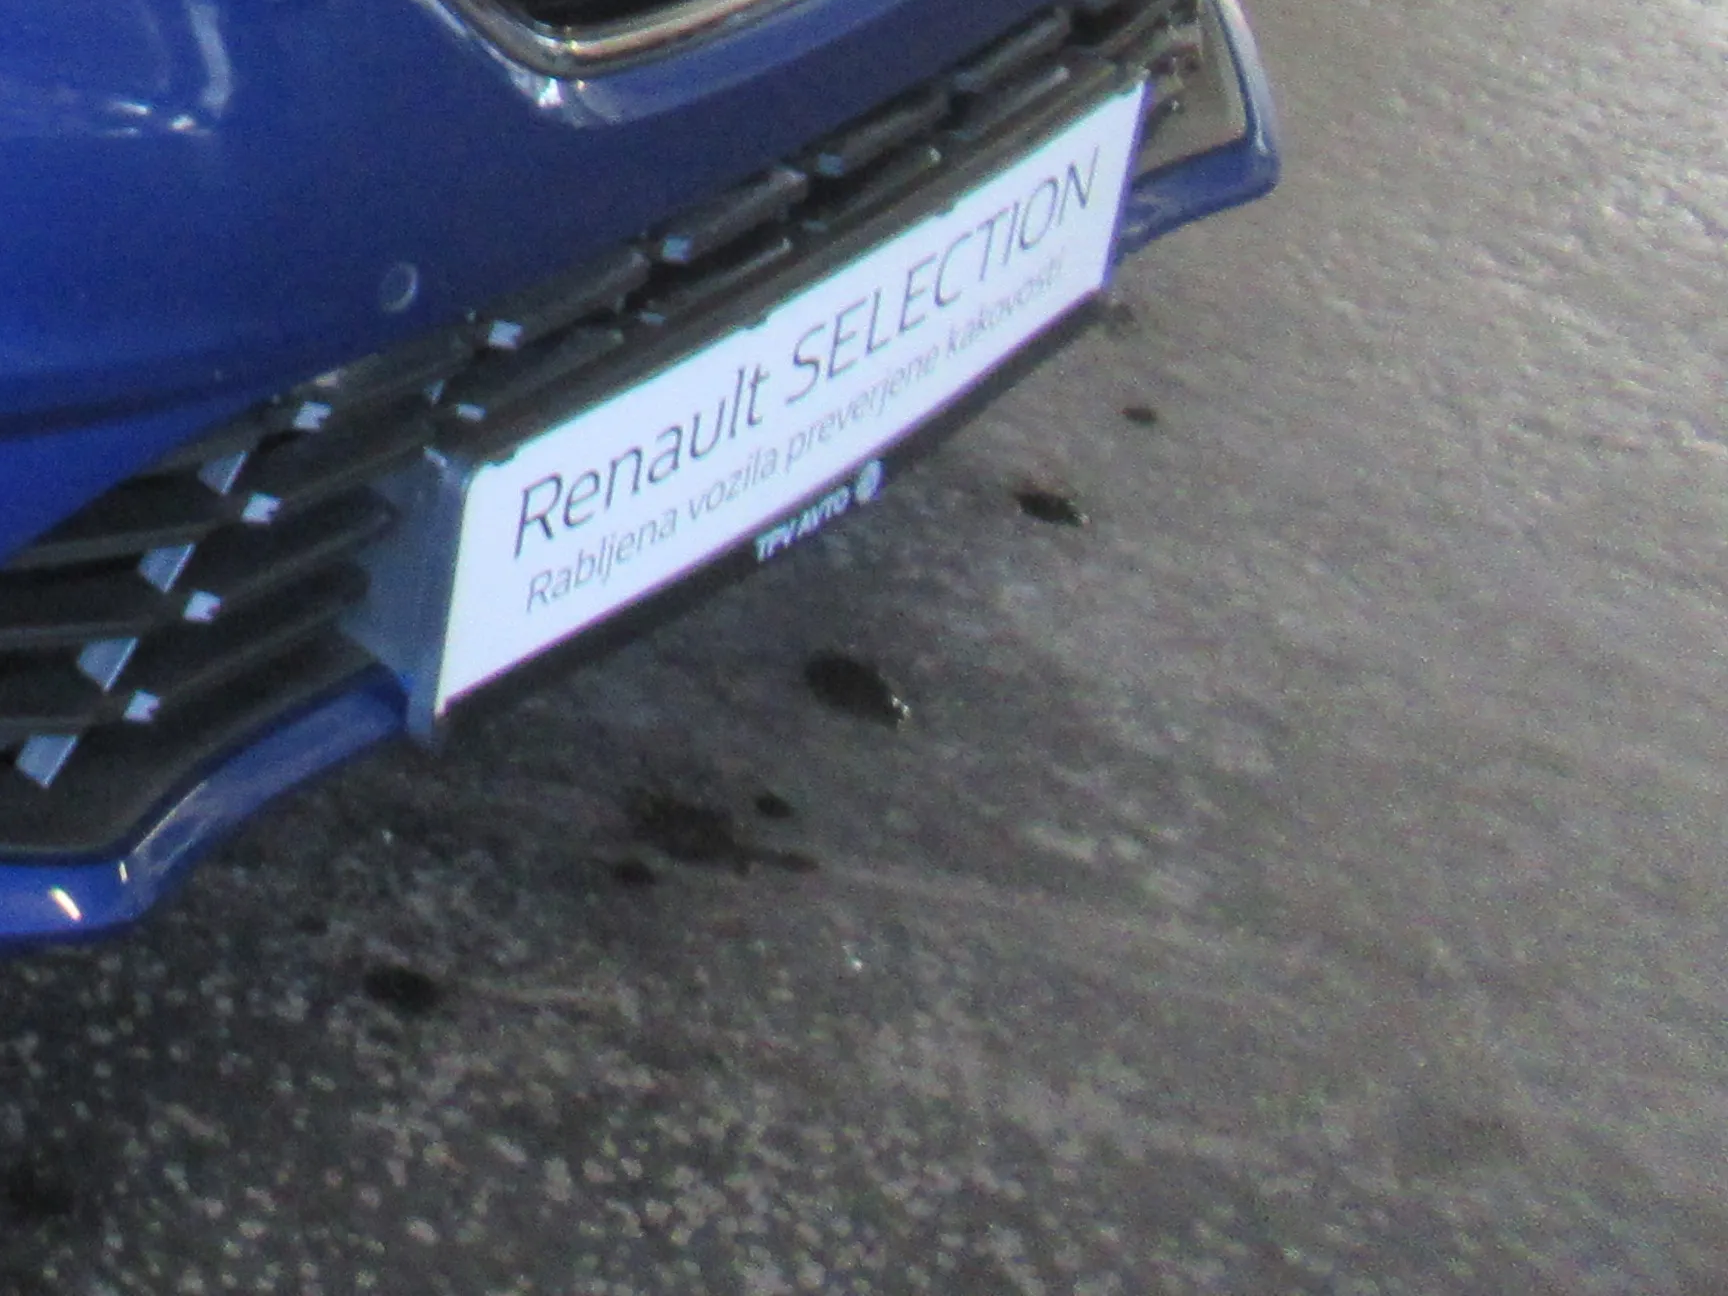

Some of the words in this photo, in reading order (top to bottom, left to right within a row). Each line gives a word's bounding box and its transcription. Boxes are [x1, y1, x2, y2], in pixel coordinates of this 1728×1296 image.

[514, 363, 769, 559] Renault
[785, 144, 1100, 405] SELECTION
[526, 507, 678, 613] Rabljena
[688, 446, 778, 520] vozila
[785, 345, 940, 474] preverjene
[945, 246, 1065, 360] kakovosti
